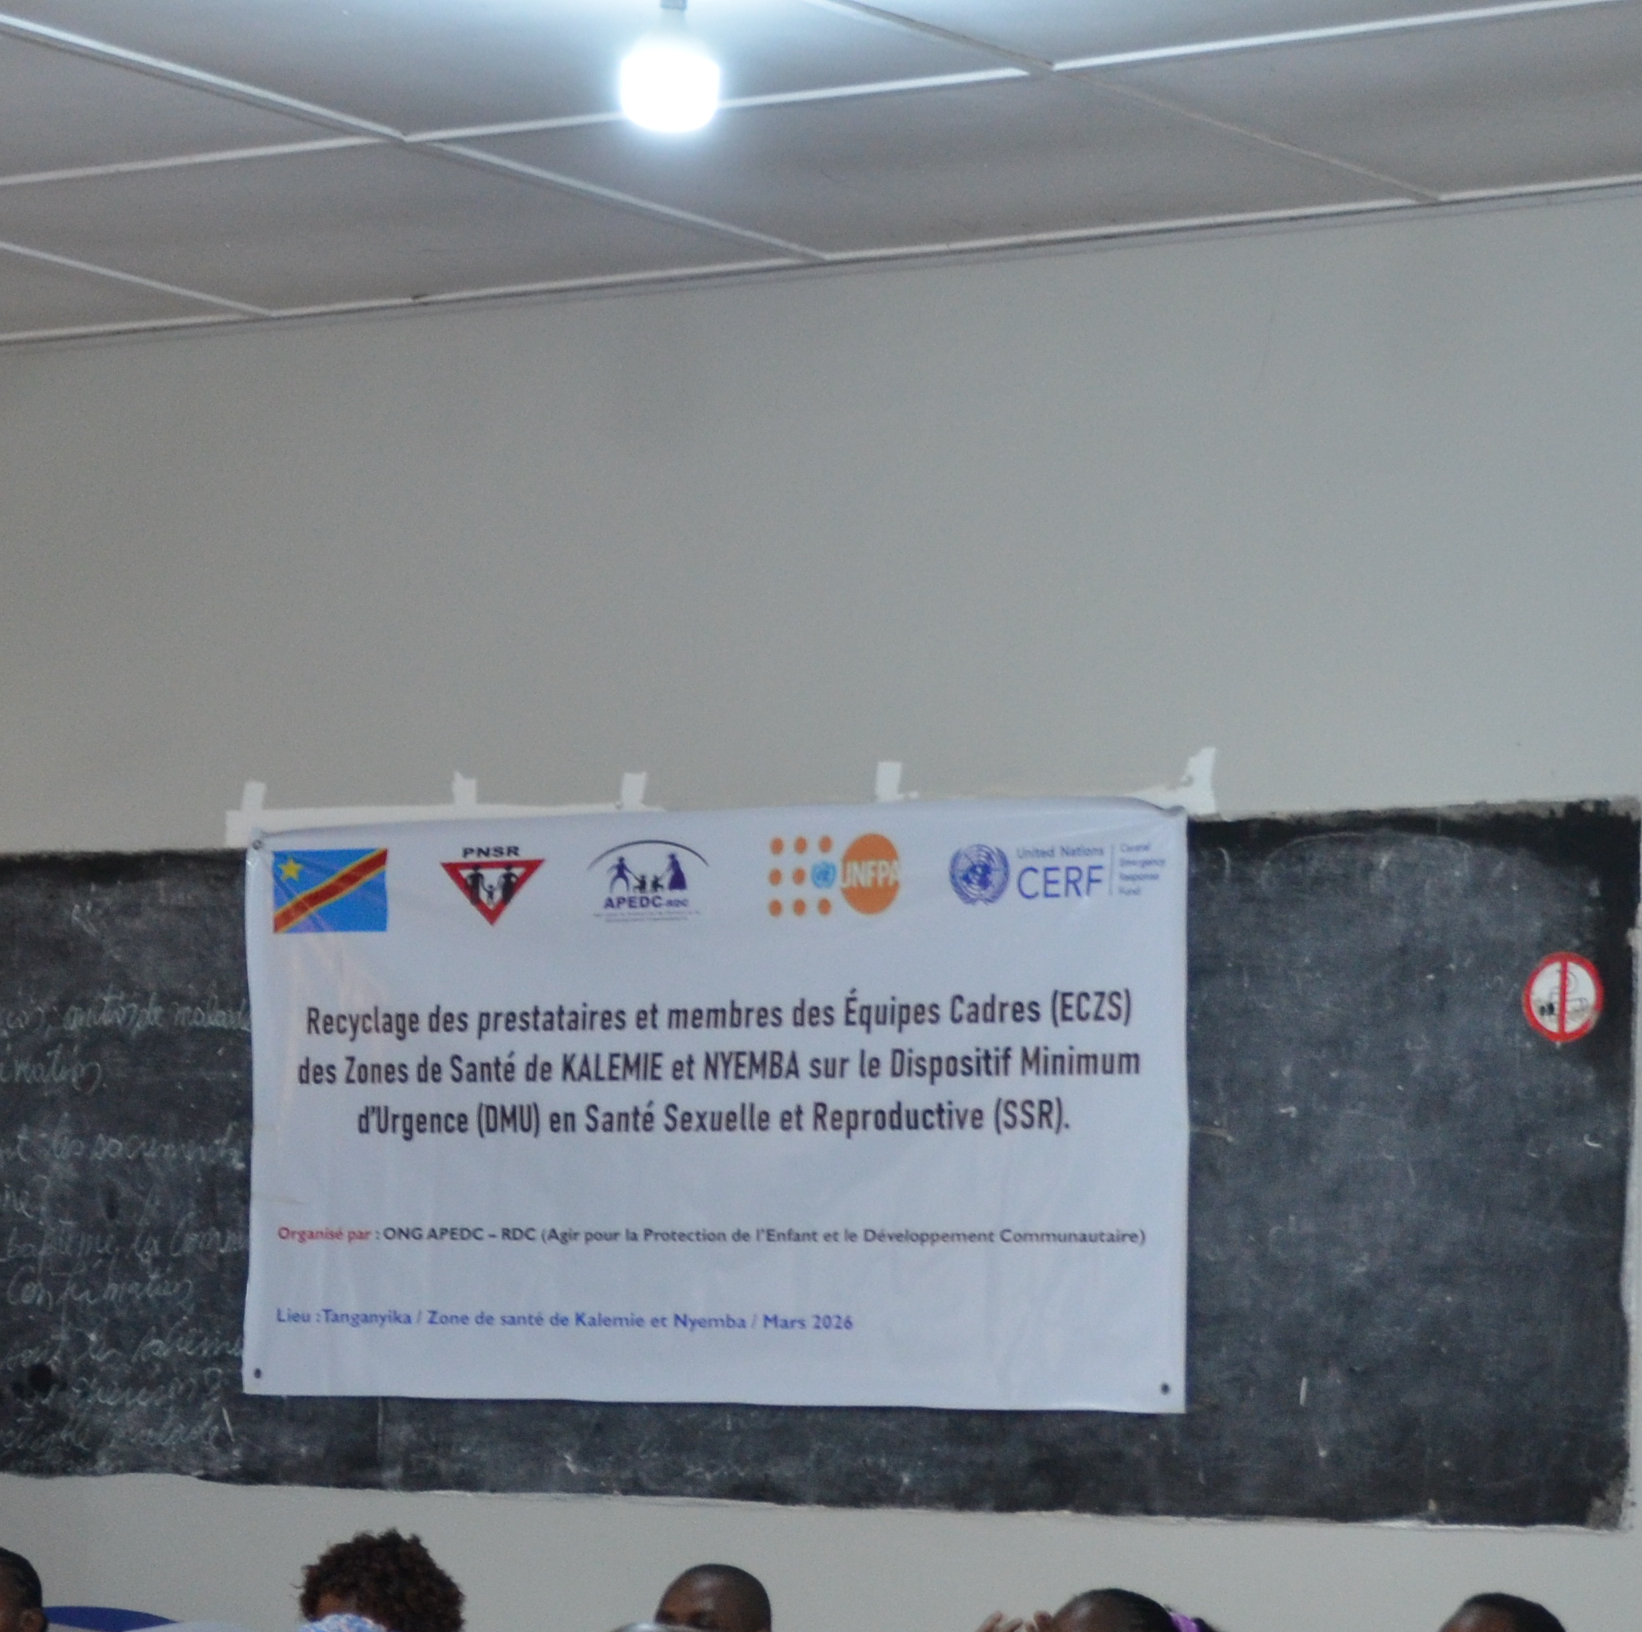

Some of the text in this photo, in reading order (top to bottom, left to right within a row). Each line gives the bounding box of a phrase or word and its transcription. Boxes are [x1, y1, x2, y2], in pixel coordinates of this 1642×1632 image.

[462, 845, 520, 858] PNSR
[1016, 845, 1104, 859] United Nations
[841, 859, 900, 888] UNFPA
[1017, 865, 1103, 899] CERF
[306, 988, 1132, 1043] Recyclage des prestataires et membres des Équipes Cadres (ECZS)
[297, 1045, 1141, 1086] des Zones de Santé de KALEMIE et NYEMBA sur le Dispositif Minimum
[357, 1097, 1070, 1142] d'Urgence (DMU) en Santé Sexuelle et Reproductive (SSR).
[277, 1226, 344, 1244] Organisé
[347, 1229, 372, 1244] par
[382, 1227, 424, 1241] ONG
[426, 1227, 485, 1241] APEDC
[500, 1227, 537, 1241] RDC
[541, 1227, 581, 1245] (Agir
[583, 1230, 619, 1245] pour
[624, 1228, 639, 1242] la
[643, 1228, 728, 1243] Protection
[730, 1228, 752, 1243] de
[755, 1228, 819, 1243] l'Enfant
[822, 1230, 840, 1243] et
[843, 1228, 859, 1243] le
[863, 1228, 996, 1247] Développement
[998, 1228, 1147, 1247] Communautaire)
[276, 1307, 311, 1323] Lieu
[426, 1310, 470, 1325] Zone
[474, 1310, 496, 1326] de
[499, 1311, 545, 1327] santé
[548, 1311, 570, 1327] de
[574, 1312, 646, 1328] Kalemie
[649, 1315, 669, 1328] et
[673, 1313, 747, 1332] Nyemba
[762, 1314, 807, 1330] Mars
[812, 1314, 854, 1331] 2026
